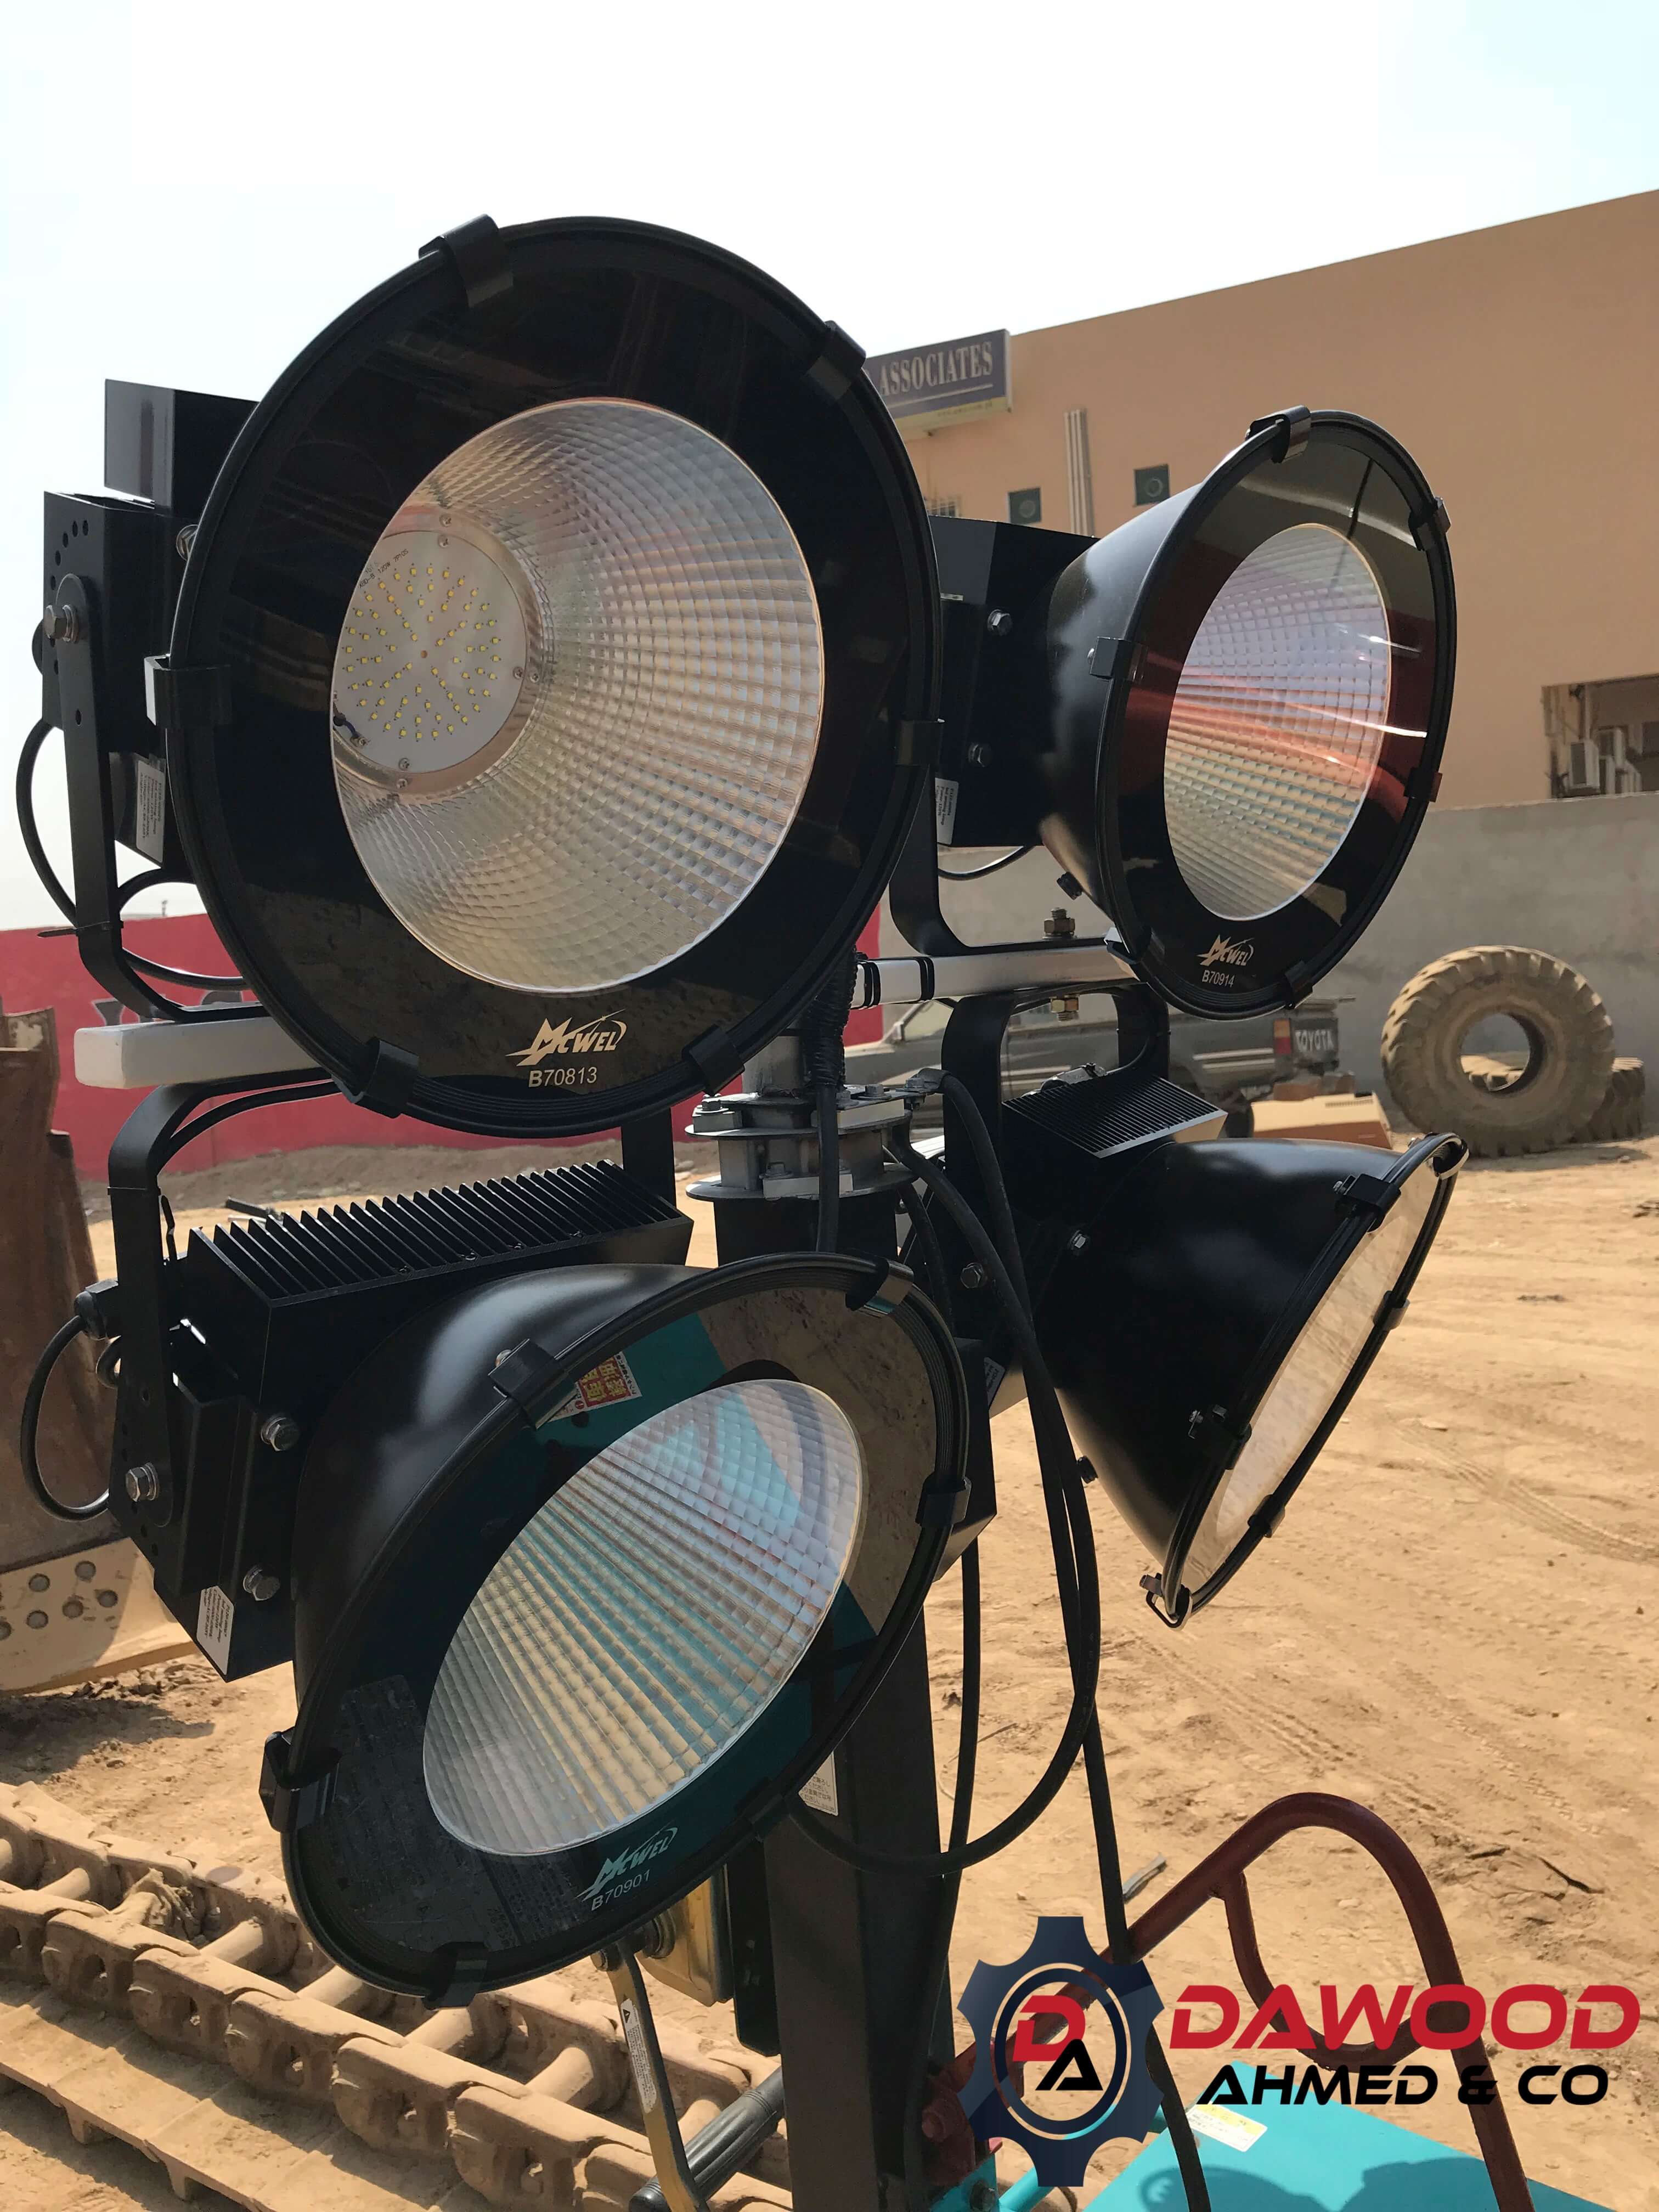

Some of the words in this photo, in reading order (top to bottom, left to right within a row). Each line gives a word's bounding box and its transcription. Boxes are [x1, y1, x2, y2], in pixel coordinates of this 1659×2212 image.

[879, 341, 993, 396] ASSOCIATES
[377, 561, 391, 573] 120W
[1201, 969, 1235, 988] B70914
[1295, 1029, 1335, 1053] TOYOTA
[528, 1066, 597, 1087] B70813
[591, 1869, 650, 1911] B70901
